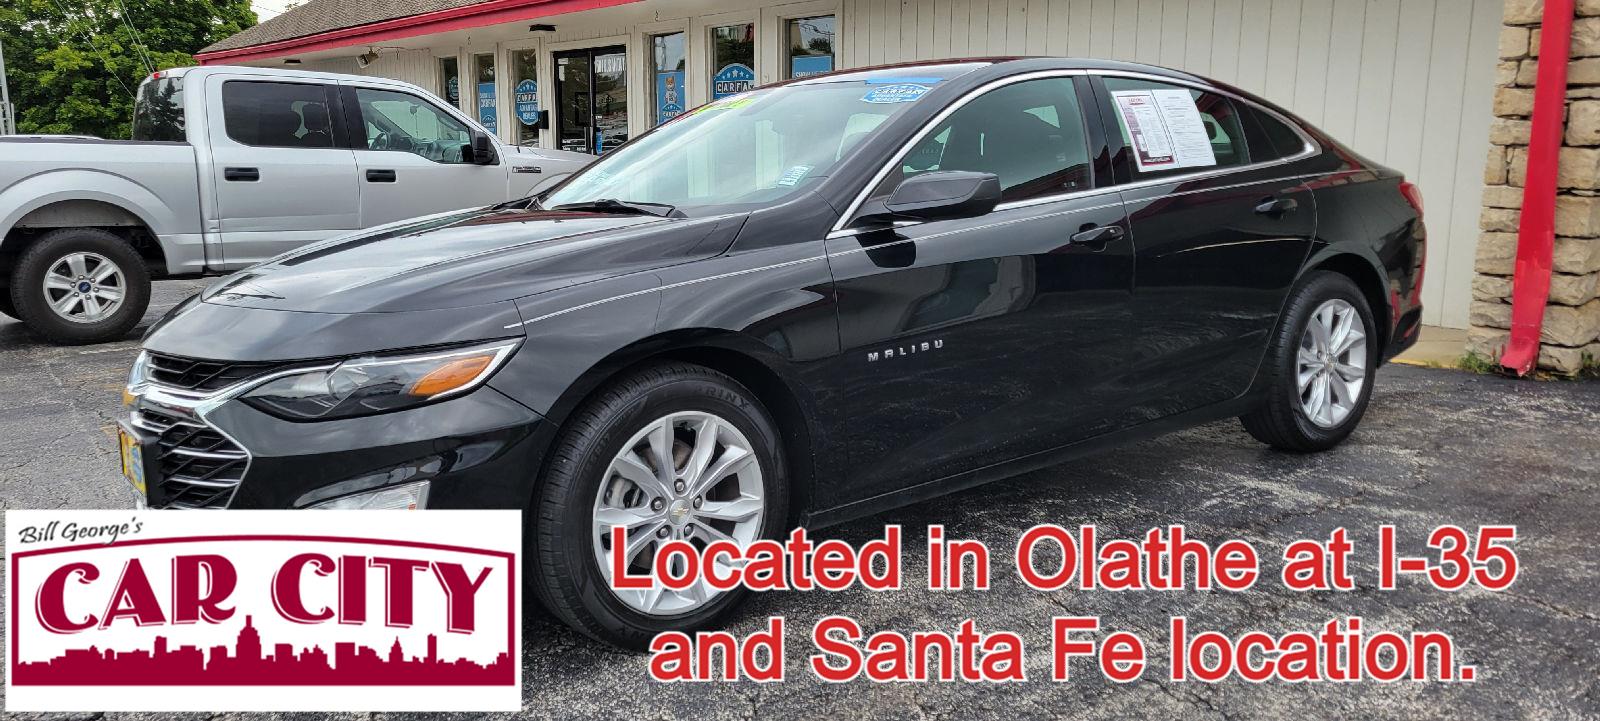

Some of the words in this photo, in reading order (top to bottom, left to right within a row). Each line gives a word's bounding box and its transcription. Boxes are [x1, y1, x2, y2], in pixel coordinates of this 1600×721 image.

[717, 81, 755, 93] CARFAX
[517, 93, 538, 103] CARFA
[867, 339, 944, 363] MALIBU
